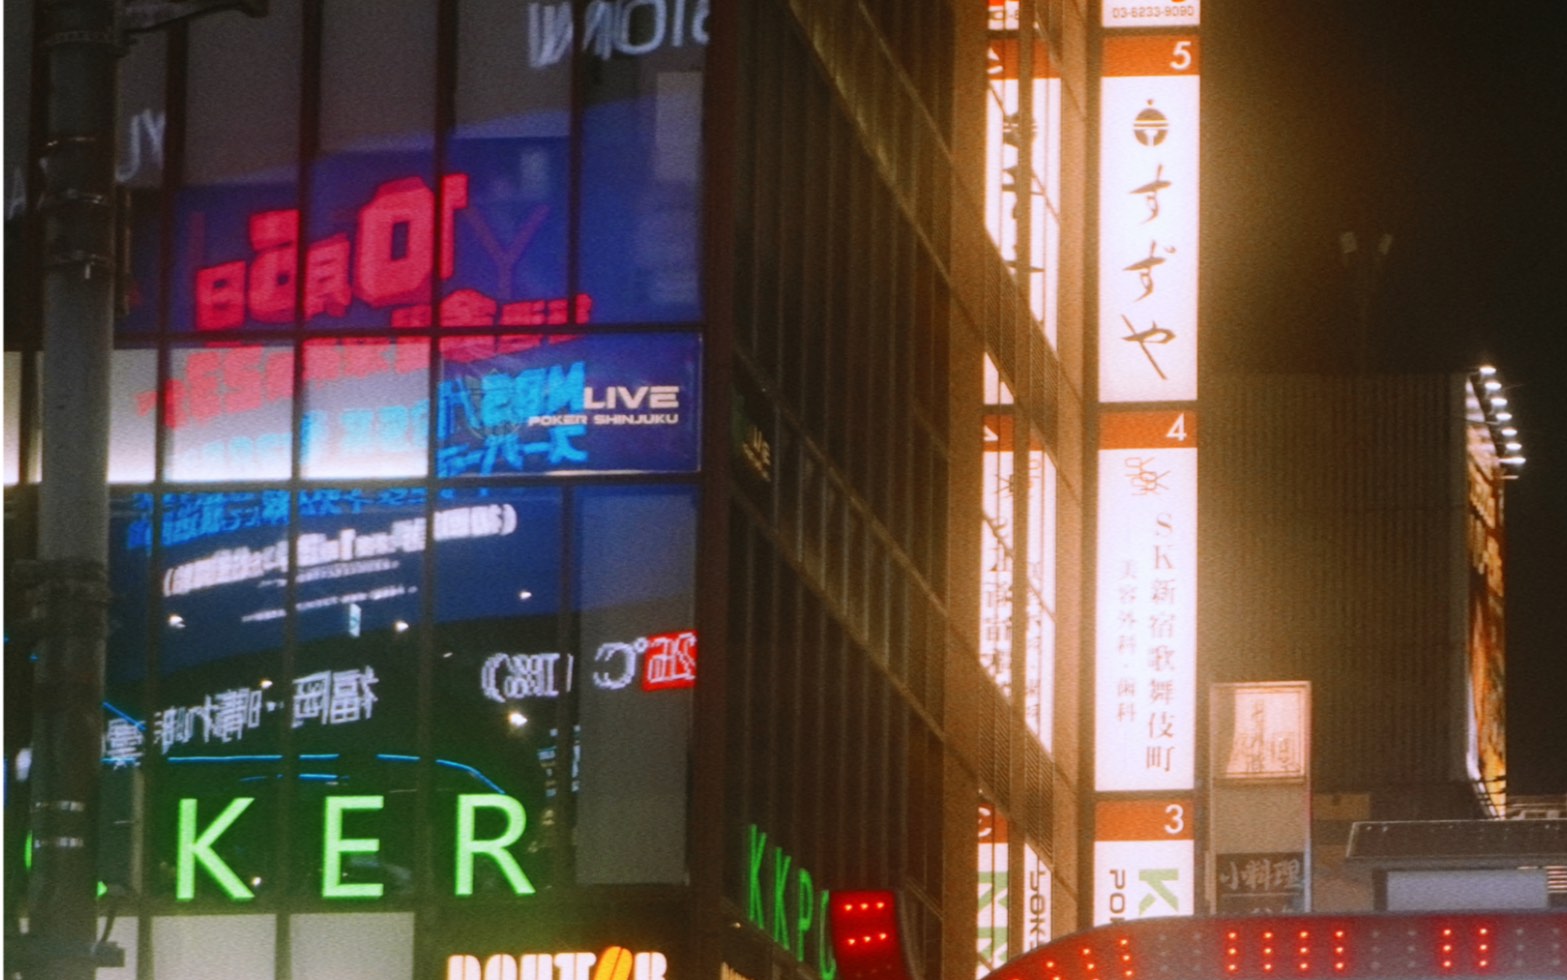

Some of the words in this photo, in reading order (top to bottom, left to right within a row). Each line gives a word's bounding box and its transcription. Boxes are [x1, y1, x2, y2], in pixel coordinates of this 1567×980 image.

[1169, 40, 1192, 71] 5
[1123, 163, 1177, 381] すずや
[583, 386, 680, 410] LIVE
[528, 414, 588, 428] POKER
[593, 413, 679, 426] SHINJUKU
[1166, 412, 1188, 441] 4
[1163, 804, 1184, 835] 3
